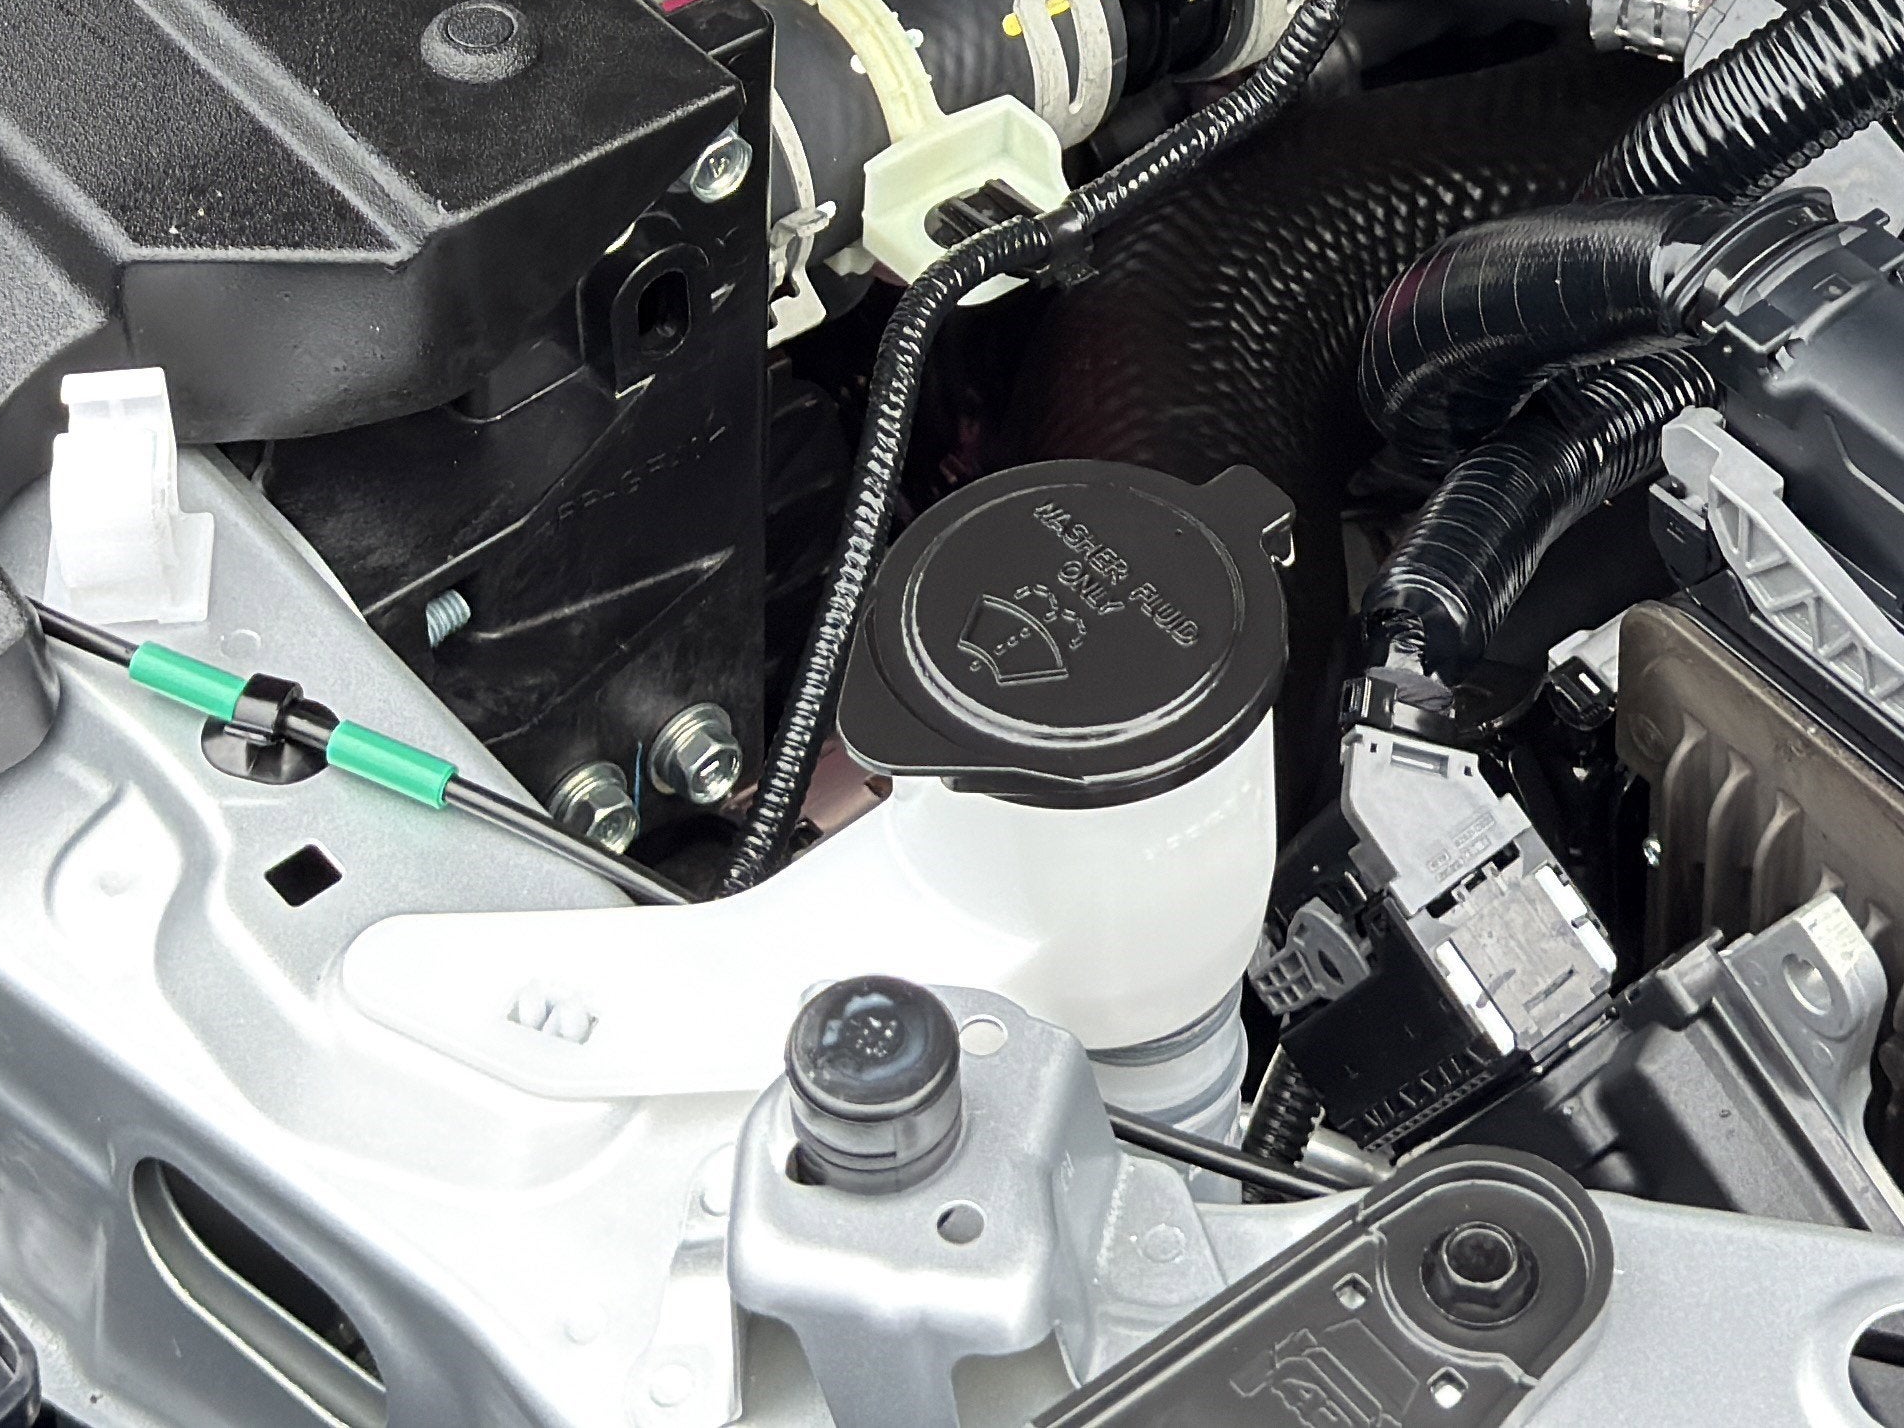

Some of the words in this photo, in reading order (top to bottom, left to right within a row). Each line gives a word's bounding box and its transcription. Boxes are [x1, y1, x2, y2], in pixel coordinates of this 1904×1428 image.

[1034, 500, 1129, 584] WASHER
[1129, 581, 1200, 649] FLUID
[1056, 559, 1125, 617] ONLY
